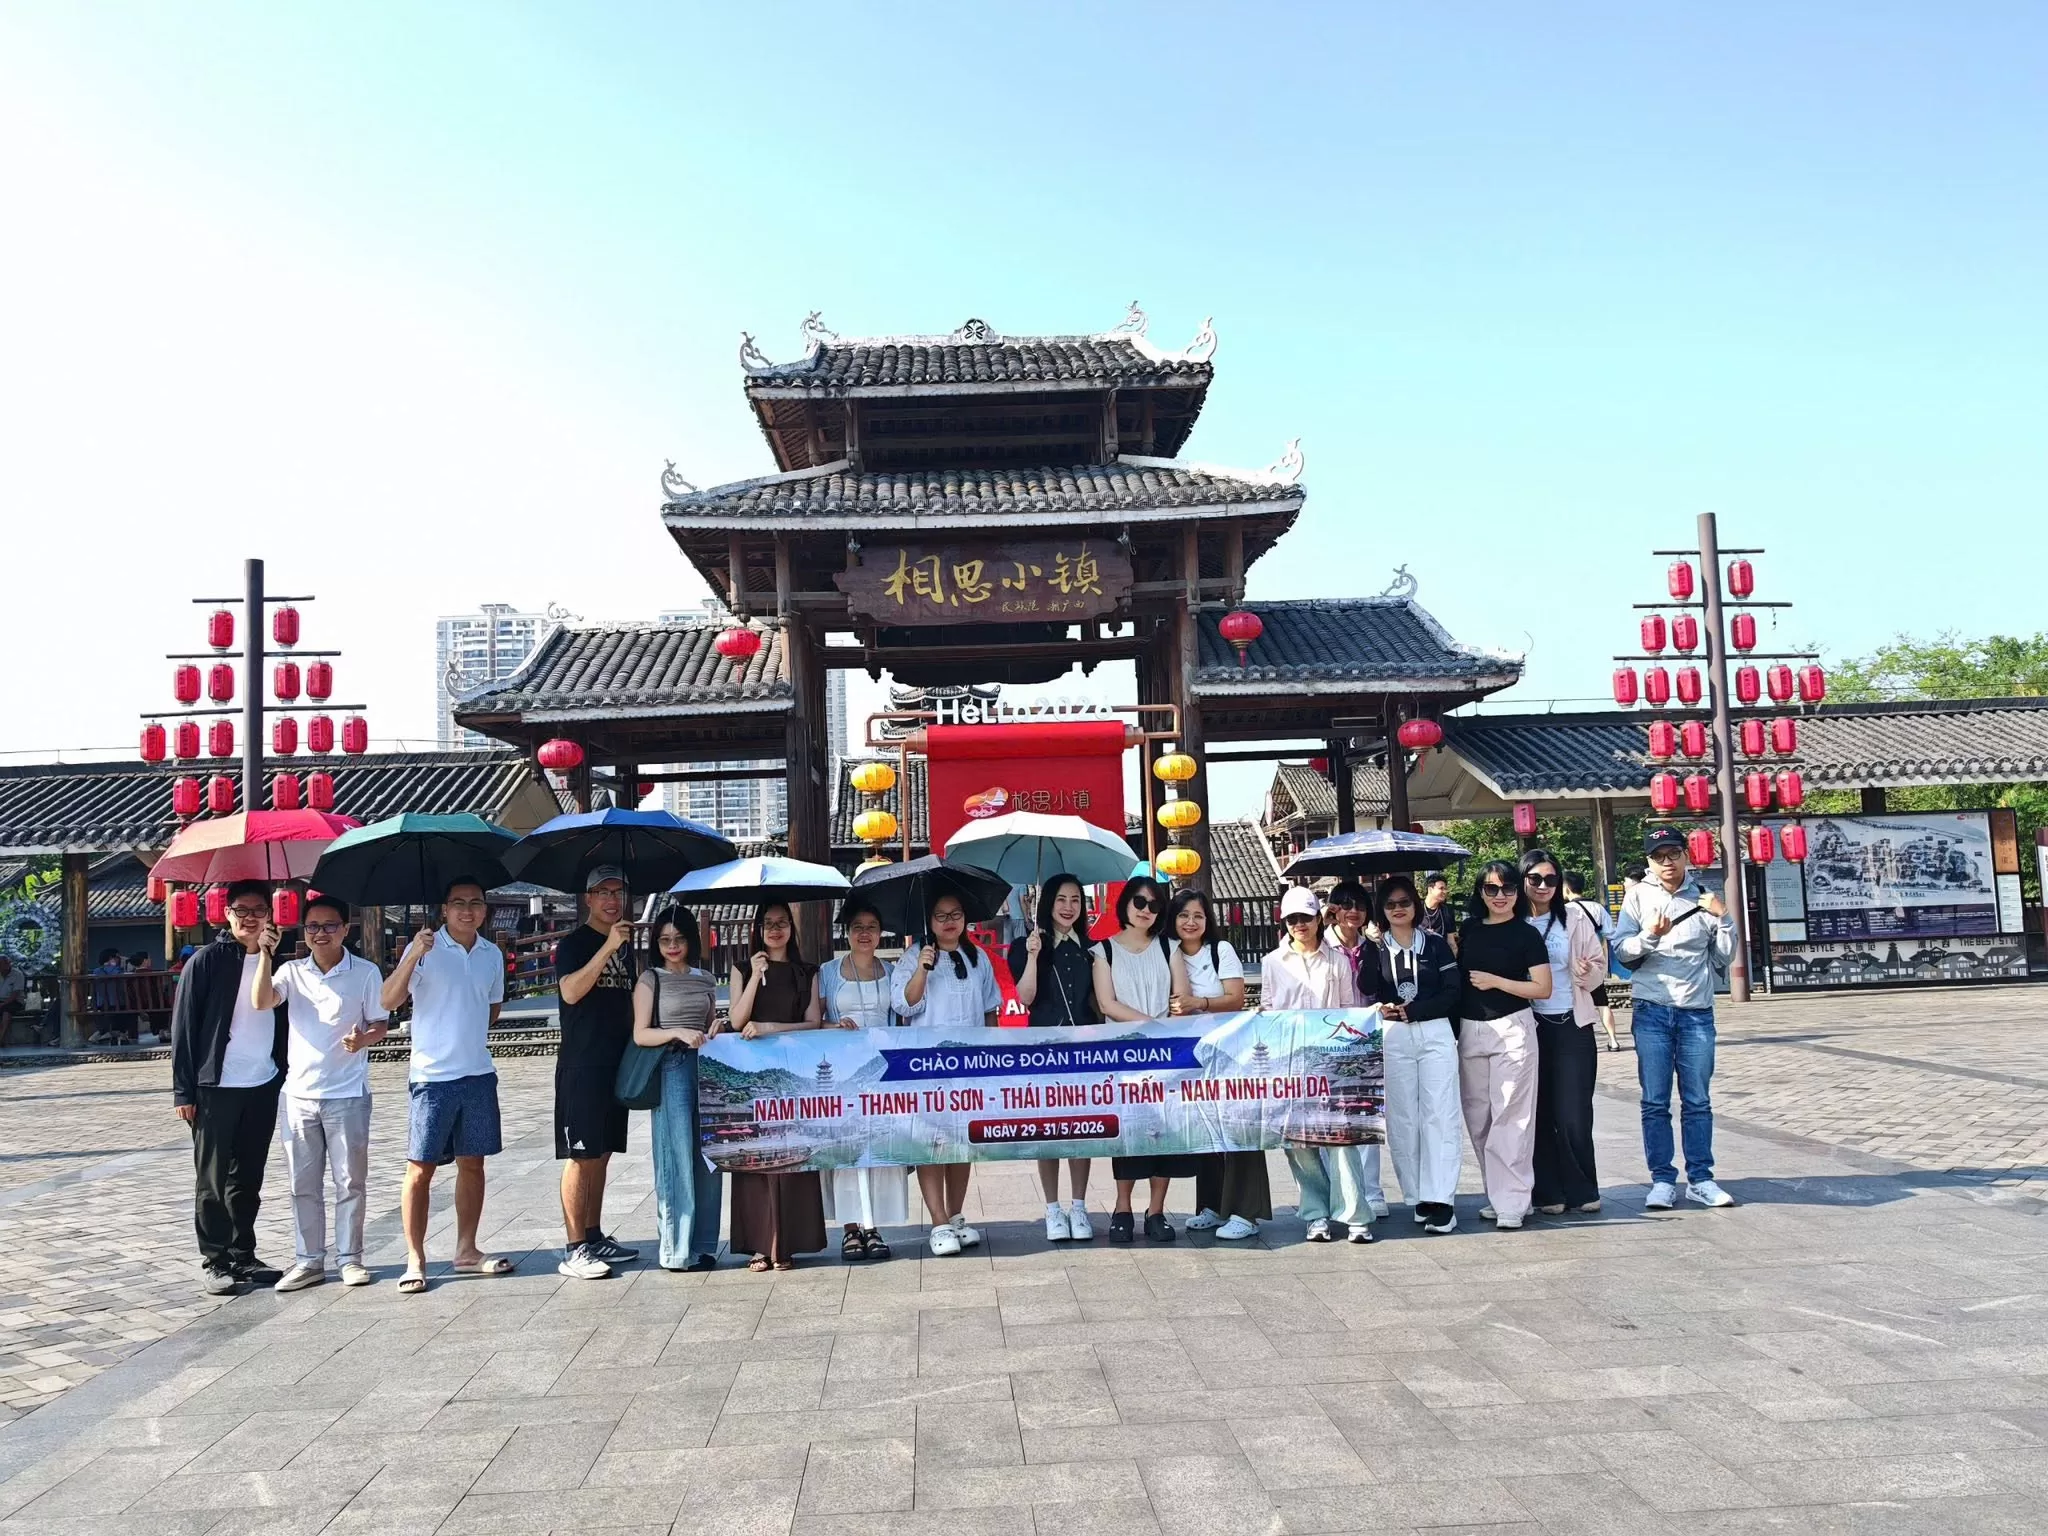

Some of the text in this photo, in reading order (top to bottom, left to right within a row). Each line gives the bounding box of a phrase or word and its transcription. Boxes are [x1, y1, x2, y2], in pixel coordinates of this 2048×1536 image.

[881, 542, 1103, 607] 相思小镇
[1011, 790, 1090, 811] 相思小镇
[1809, 943, 1835, 952] STYLE
[1960, 938, 1975, 947] THE
[909, 1047, 1172, 1072] CHÀO MỪNG ĐOÀN THAM QUAN
[754, 1098, 795, 1122] NAM
[800, 1095, 842, 1119] NINH
[859, 1092, 918, 1116] THANH
[923, 1086, 945, 1113] TÚ
[949, 1088, 984, 1112] SƠN
[1000, 1082, 1040, 1109] THÁI
[1045, 1081, 1087, 1108] BÌNH
[1091, 1074, 1114, 1105] CỔ
[1118, 1075, 1164, 1104] TRẤN
[1181, 1079, 1220, 1102] NAM
[1225, 1078, 1267, 1100] NINH
[1272, 1076, 1301, 1099] CHI
[1306, 1076, 1330, 1101] DẠ
[983, 1122, 1017, 1138] NGÀY
